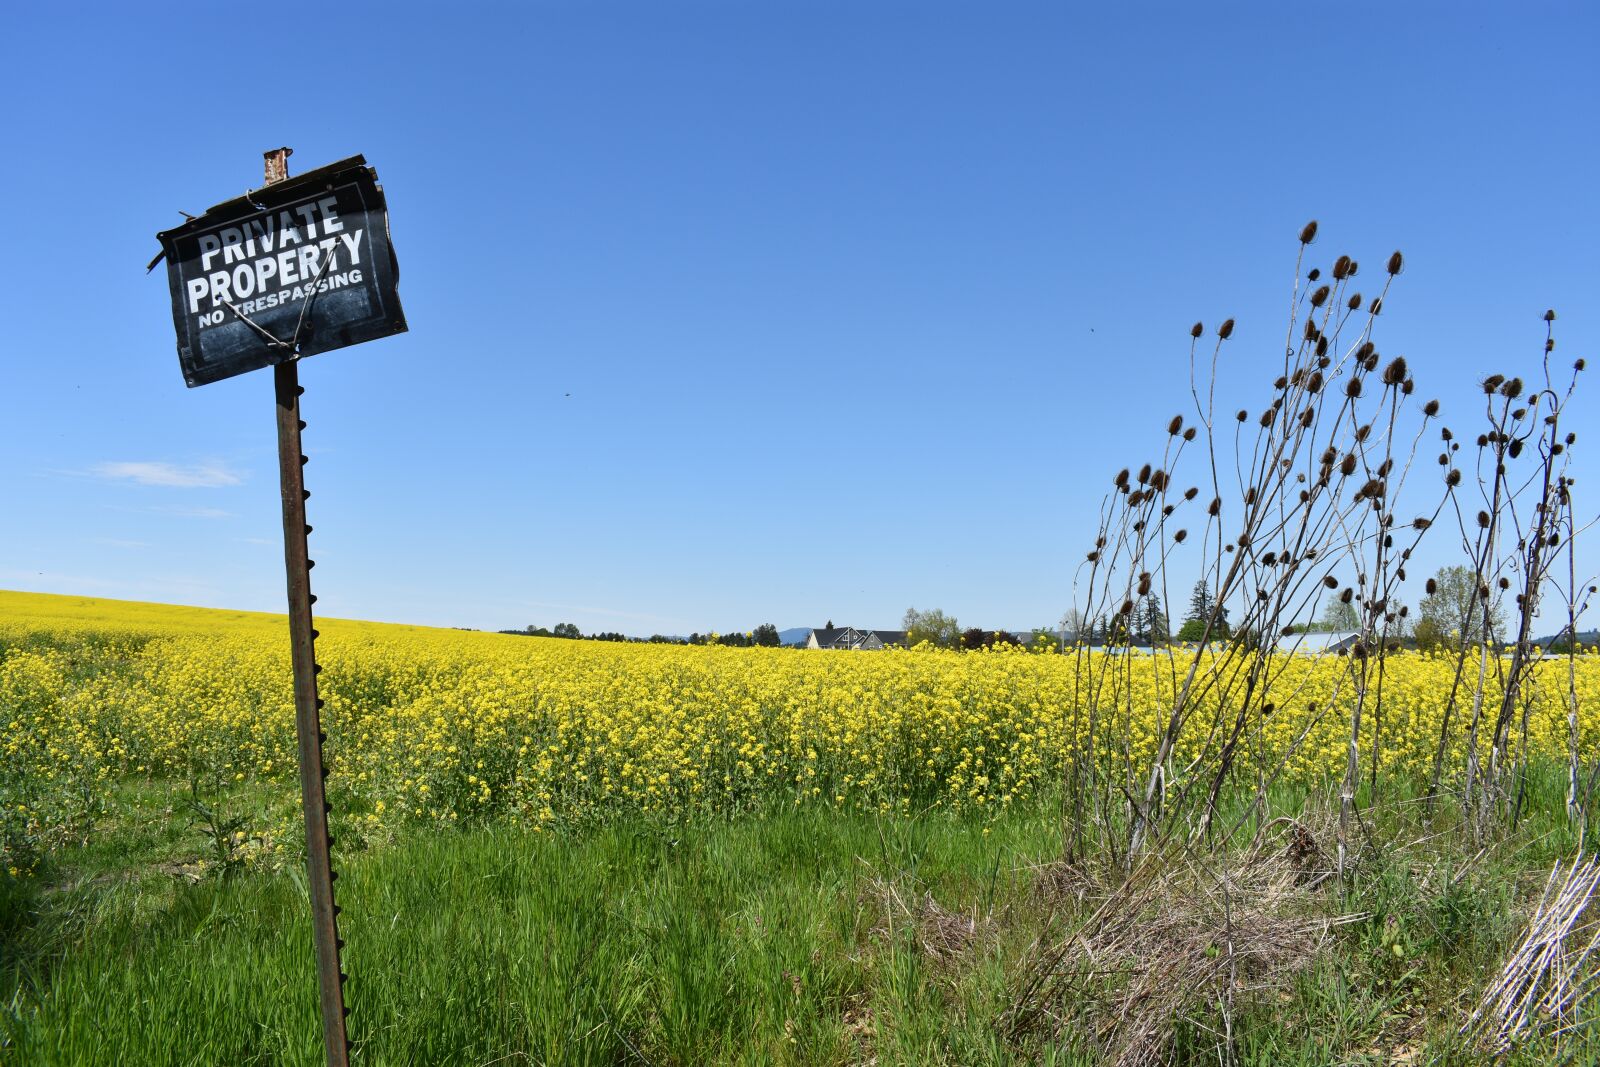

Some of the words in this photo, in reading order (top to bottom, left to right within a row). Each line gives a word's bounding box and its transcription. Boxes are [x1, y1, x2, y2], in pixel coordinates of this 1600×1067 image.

[198, 196, 344, 271] PRIVATE
[187, 229, 363, 314] PROPERTY
[198, 309, 225, 329] NO
